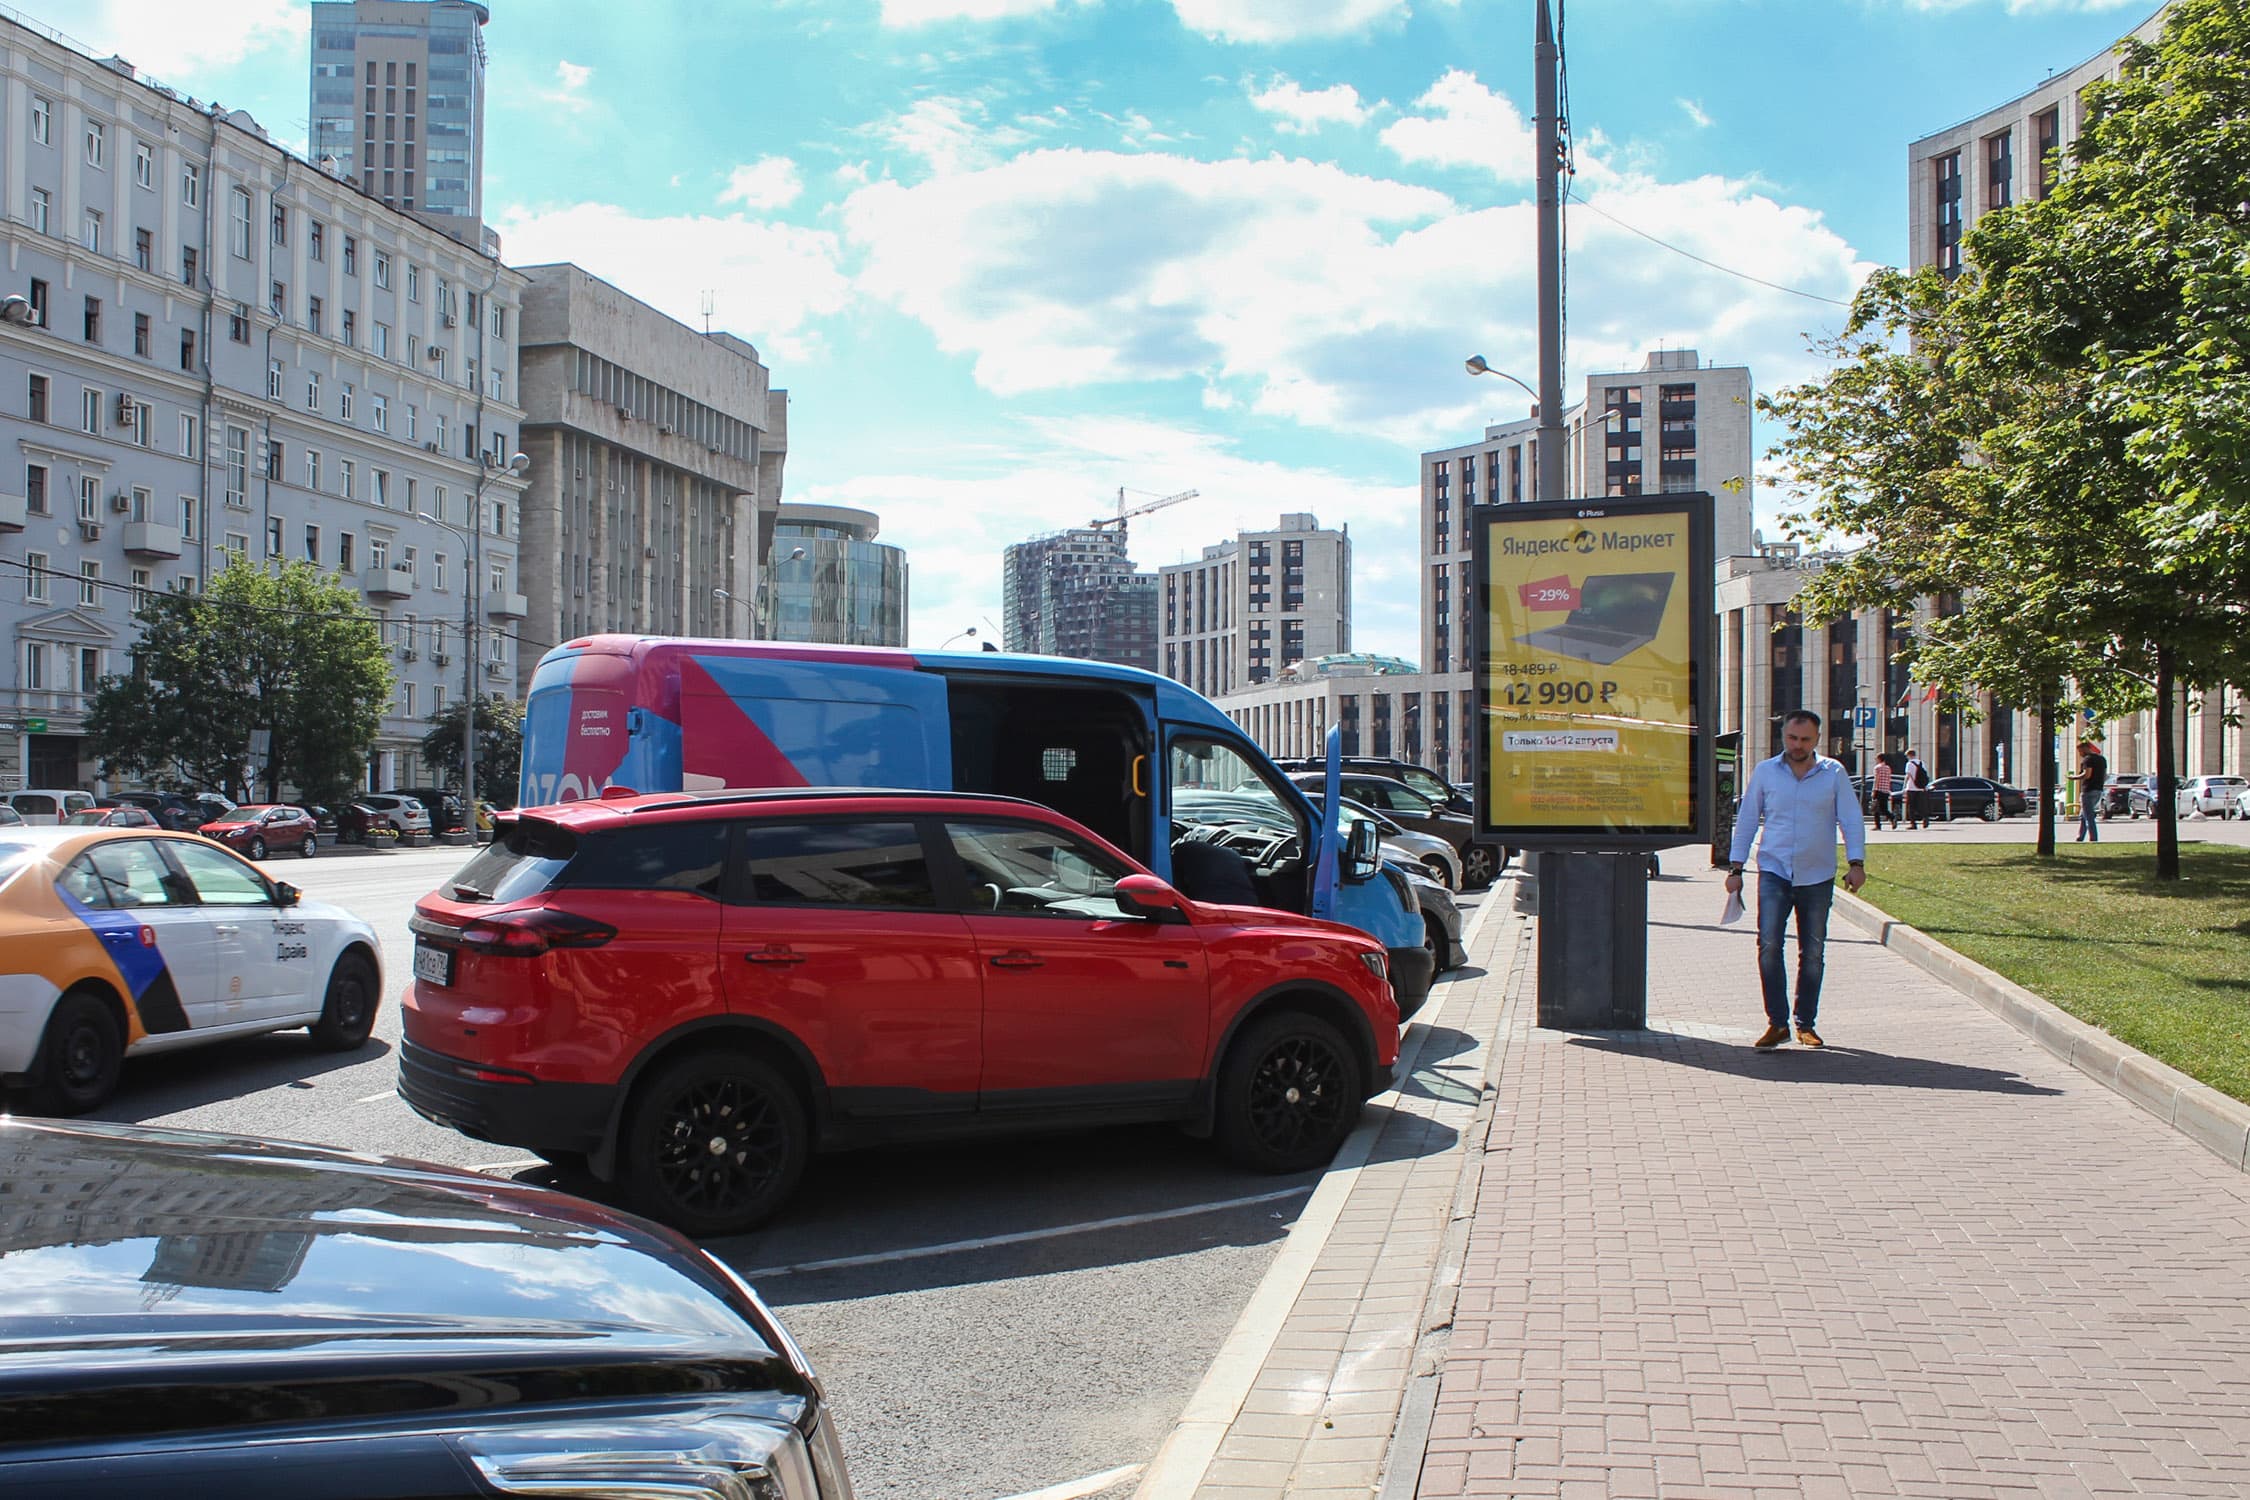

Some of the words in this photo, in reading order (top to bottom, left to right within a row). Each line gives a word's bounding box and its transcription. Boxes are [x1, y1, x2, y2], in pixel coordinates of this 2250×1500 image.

[1502, 537, 1569, 556] Яндекс
[1602, 530, 1675, 552] Маркет
[1529, 588, 1570, 602] -29%
[1520, 663, 1546, 675] 489
[1504, 682, 1531, 705] 12
[1538, 681, 1594, 704] 990
[582, 710, 608, 720] доставим
[1859, 710, 1872, 726] P
[581, 724, 610, 736] бесплатно
[1508, 736, 1543, 746] Только
[1576, 736, 1614, 747] августа
[277, 942, 308, 962] Драйв
